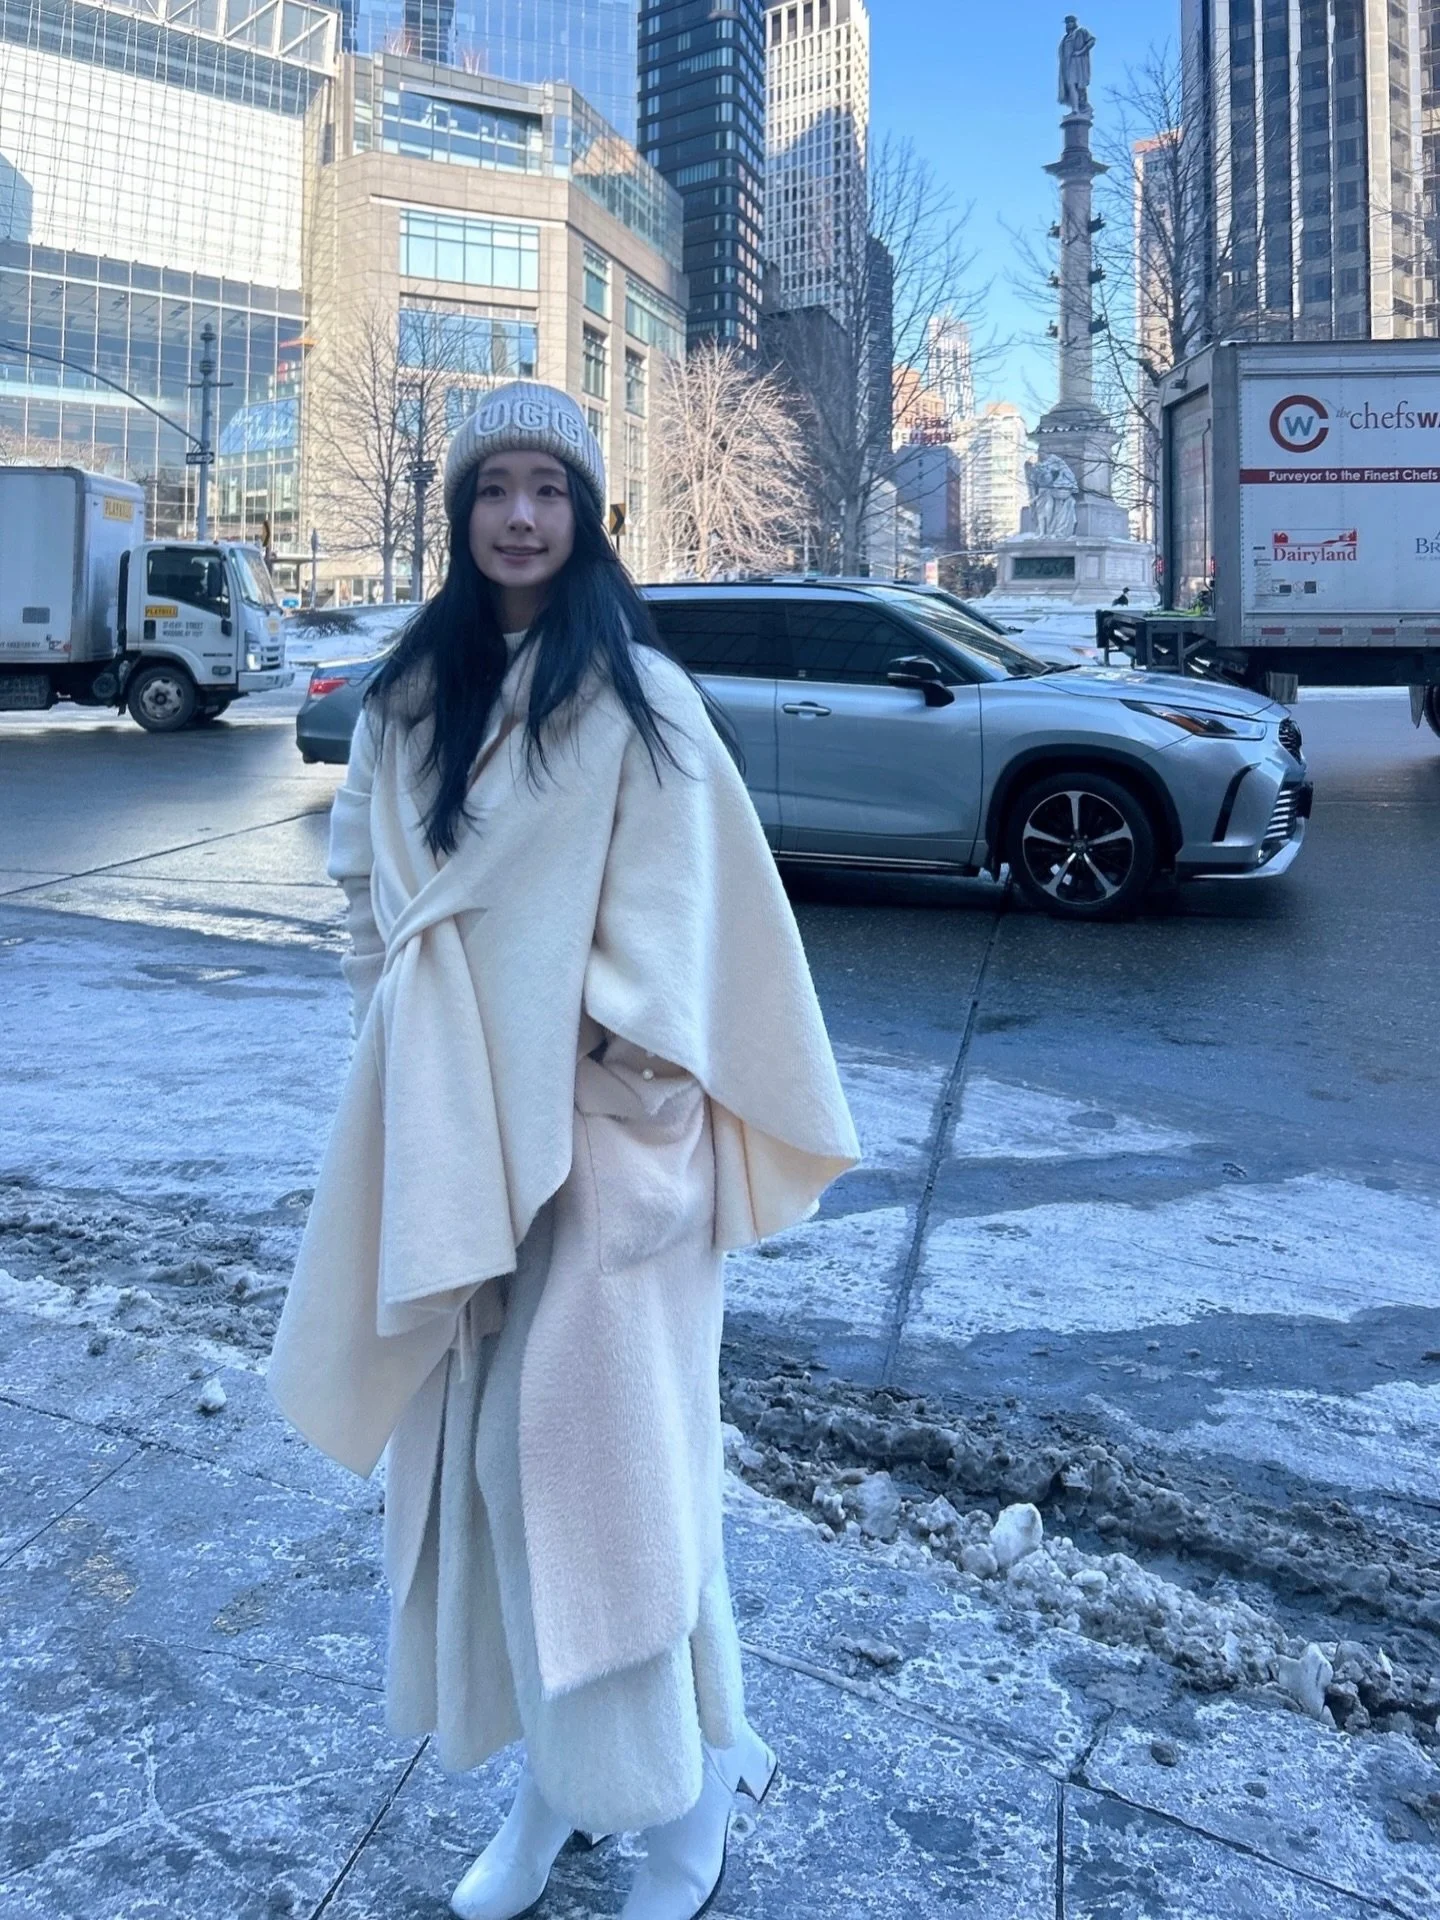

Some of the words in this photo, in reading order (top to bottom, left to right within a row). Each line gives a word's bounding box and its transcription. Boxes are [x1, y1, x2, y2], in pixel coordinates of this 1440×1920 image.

[475, 401, 583, 447] UGG
[1269, 471, 1322, 483] Purveyor
[1325, 470, 1338, 481] to
[1341, 470, 1361, 480] the
[1364, 470, 1400, 480] Finest
[1402, 469, 1439, 480] Chefs
[1273, 547, 1357, 564] Dairyland
